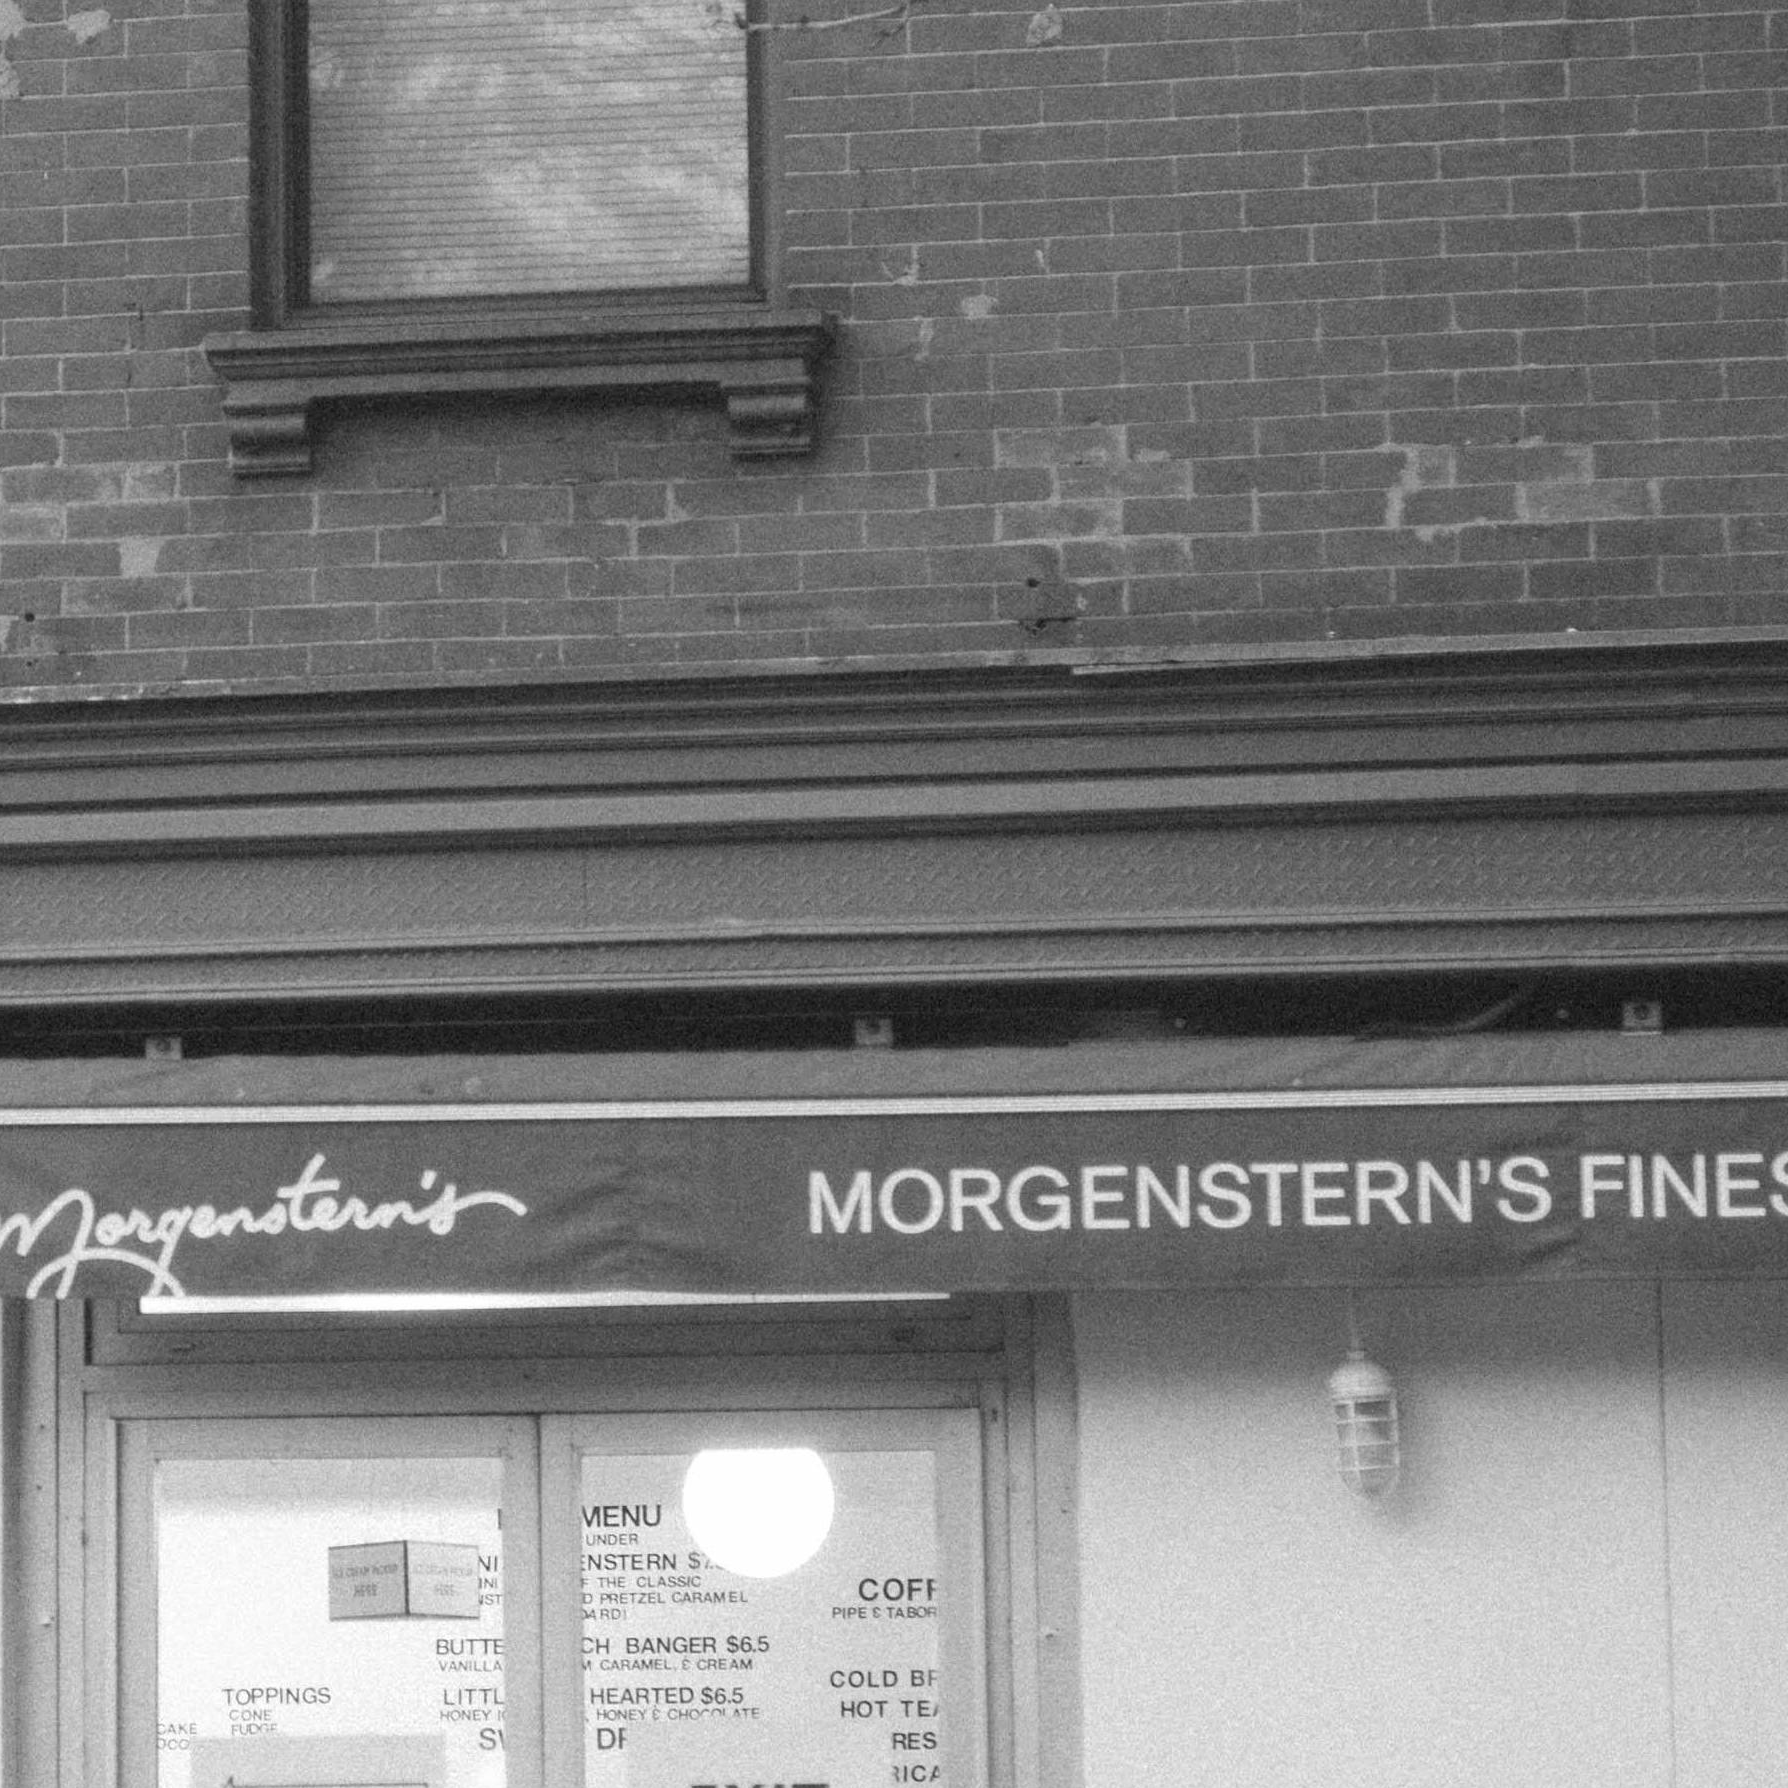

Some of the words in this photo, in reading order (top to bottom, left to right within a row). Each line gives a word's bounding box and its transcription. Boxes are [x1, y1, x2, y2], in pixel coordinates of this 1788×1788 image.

[810, 1154, 1552, 1234] MORGENSTERN'S
[597, 1577, 626, 1588] THE
[636, 1575, 702, 1588] CLASSIC
[600, 1592, 666, 1604] PRETZEL
[671, 1591, 749, 1604] CARAMEL
[832, 1606, 868, 1619] PIPE
[626, 1636, 717, 1654] BANGER
[726, 1635, 770, 1653] $6.5
[696, 1658, 754, 1670] CREAM
[830, 1670, 899, 1688] COLD
[222, 1687, 332, 1706] TOPPINGS
[590, 1687, 695, 1704] HEARTED
[700, 1686, 744, 1704] $6.5
[228, 1709, 273, 1721] CONE
[439, 1709, 491, 1721] HONEY
[596, 1708, 646, 1721] HONEY
[841, 1700, 889, 1718] HOT
